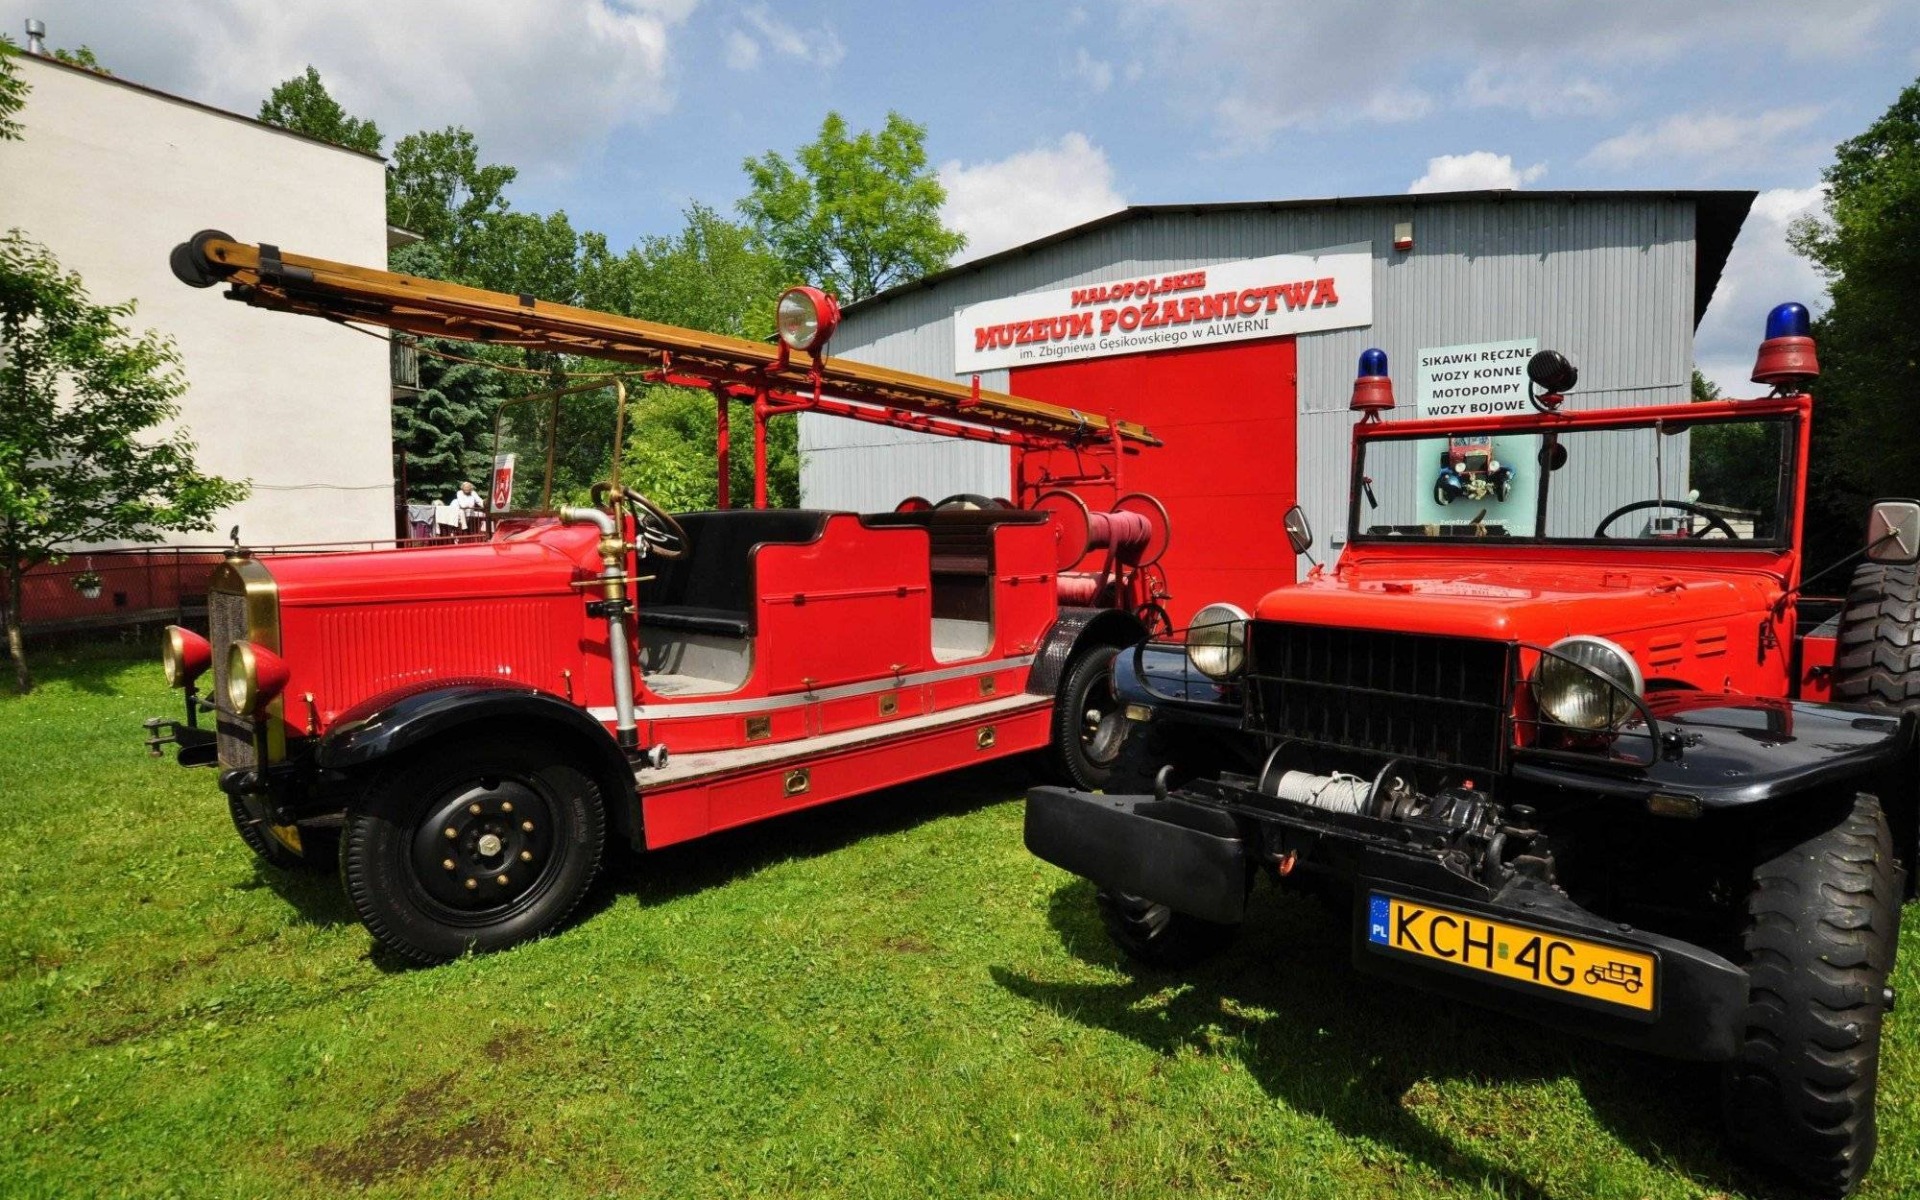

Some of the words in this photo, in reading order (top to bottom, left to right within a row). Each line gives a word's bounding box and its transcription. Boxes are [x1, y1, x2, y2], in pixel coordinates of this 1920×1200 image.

[975, 312, 1095, 351] MUZEUM
[1100, 278, 1339, 335] POŻARNICTWA
[1019, 348, 1036, 360] im.
[1039, 342, 1096, 359] Zbigniewa
[1099, 331, 1188, 351] Gęsikowskiego
[1192, 330, 1203, 339] w
[1207, 318, 1269, 337] ALWERNI
[1422, 353, 1477, 367] SIKAWKI
[1481, 347, 1533, 363] RĘCZNE
[1431, 370, 1469, 382] WOZY
[1474, 366, 1522, 379] KONNE
[1432, 384, 1520, 399] MOTOPOMPY
[1428, 404, 1467, 415] WOZY
[1470, 400, 1526, 414] BOJOWE
[1372, 923, 1387, 938] PL
[1396, 905, 1494, 969] KCH
[1514, 936, 1575, 987] 4G
